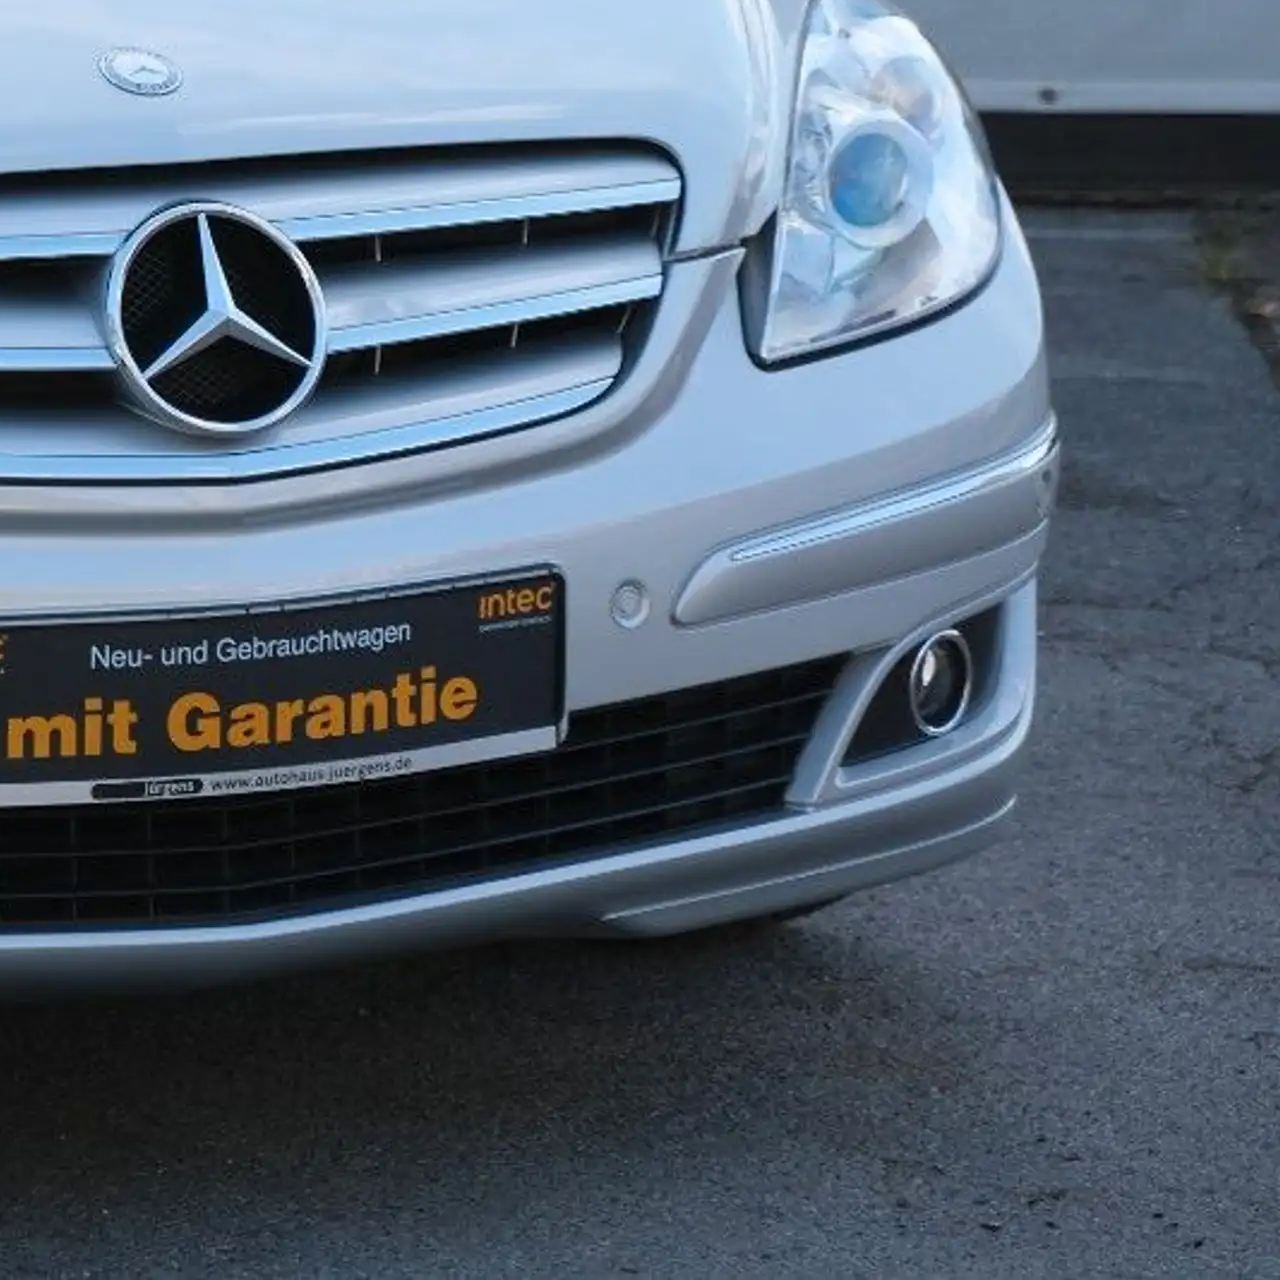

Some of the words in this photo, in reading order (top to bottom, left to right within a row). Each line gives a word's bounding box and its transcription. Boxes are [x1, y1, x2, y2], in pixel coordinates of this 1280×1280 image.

[479, 586, 552, 620] intec
[90, 644, 153, 670] Neu-
[160, 639, 209, 666] und
[216, 623, 412, 663] Gebrauchtwagen
[7, 697, 138, 759] mit
[167, 665, 478, 752] Garantie
[210, 756, 413, 792] www.autohausjuergens.de
